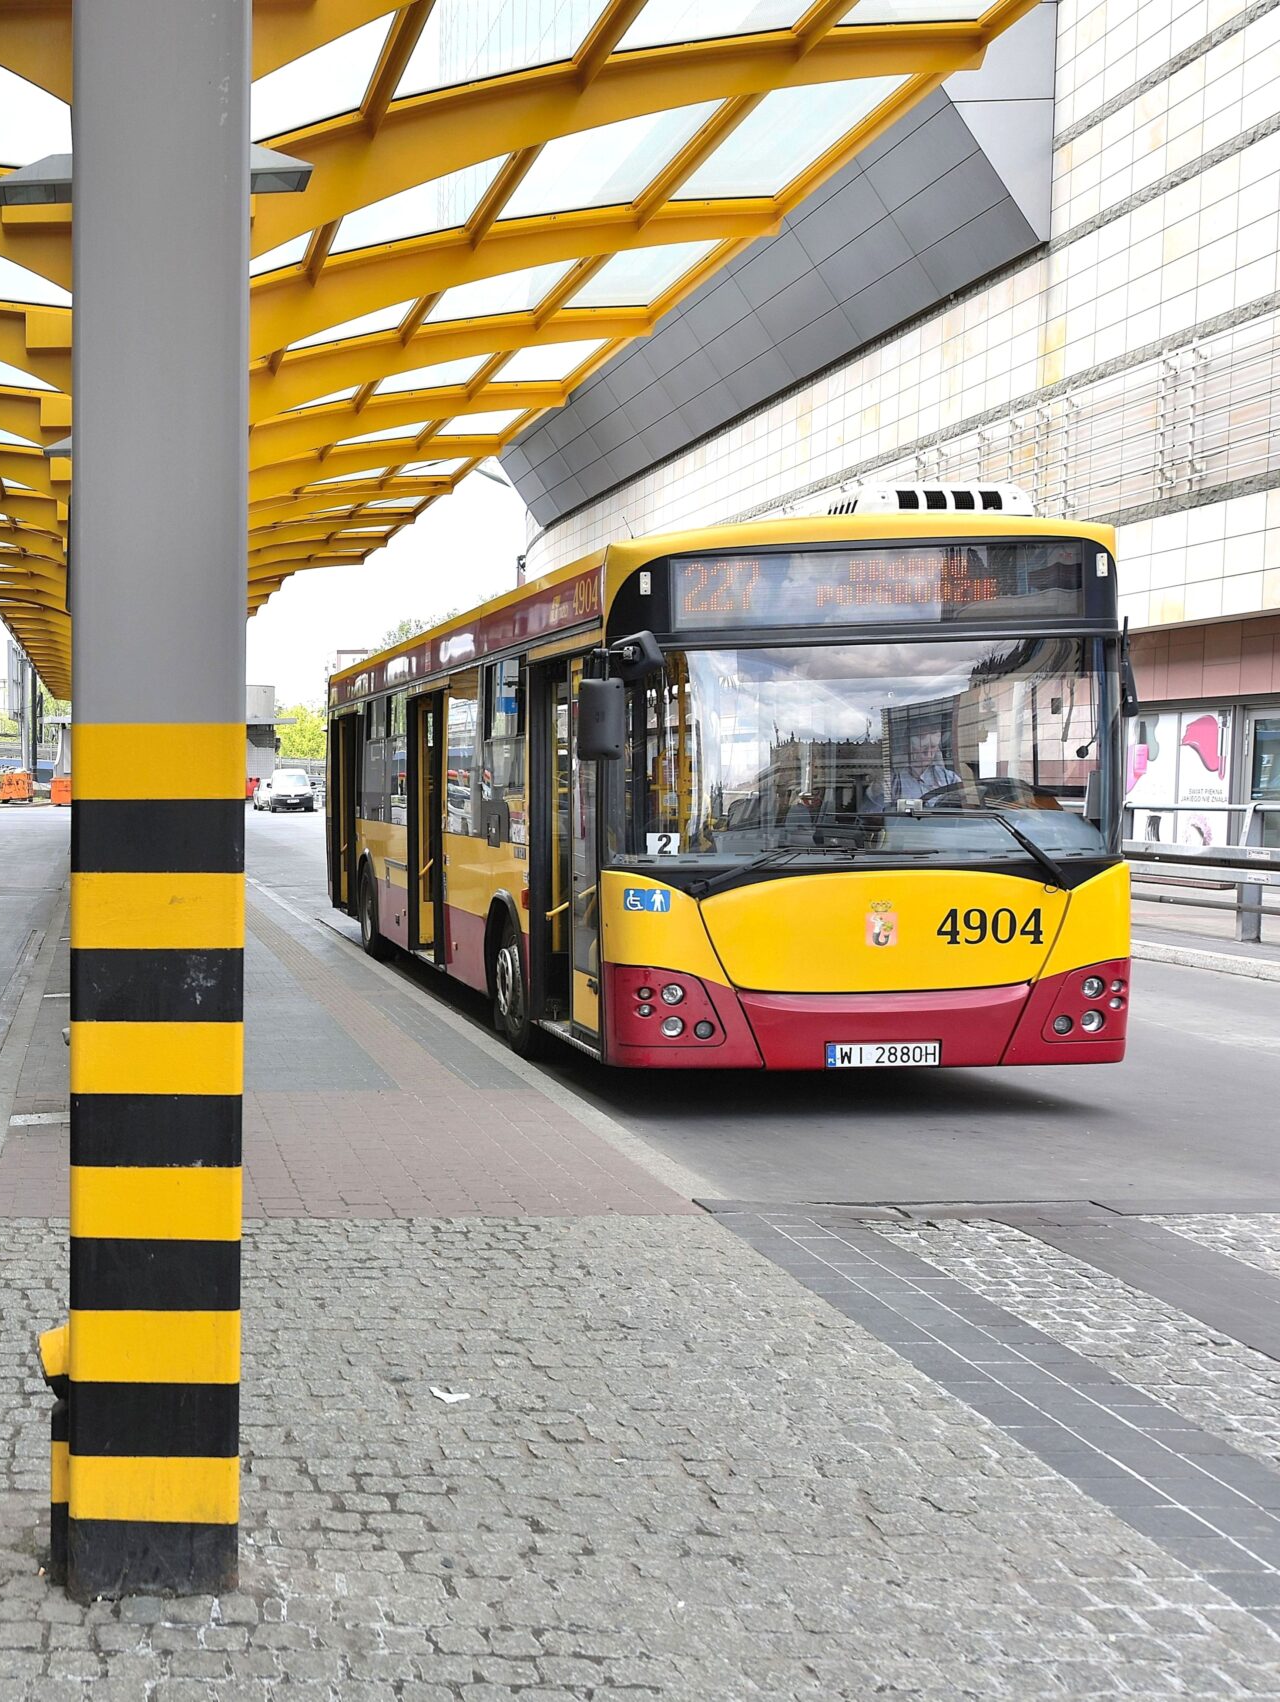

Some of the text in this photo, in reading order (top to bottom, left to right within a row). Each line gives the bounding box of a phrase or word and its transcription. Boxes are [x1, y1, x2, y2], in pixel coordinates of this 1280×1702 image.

[572, 575, 599, 616] 4904
[684, 560, 761, 612] 227
[816, 578, 998, 608] PODGRODZIE
[657, 834, 672, 855] 2
[936, 907, 1044, 945] 4904
[839, 1046, 863, 1065] WI
[875, 1045, 937, 1064] 2880H
